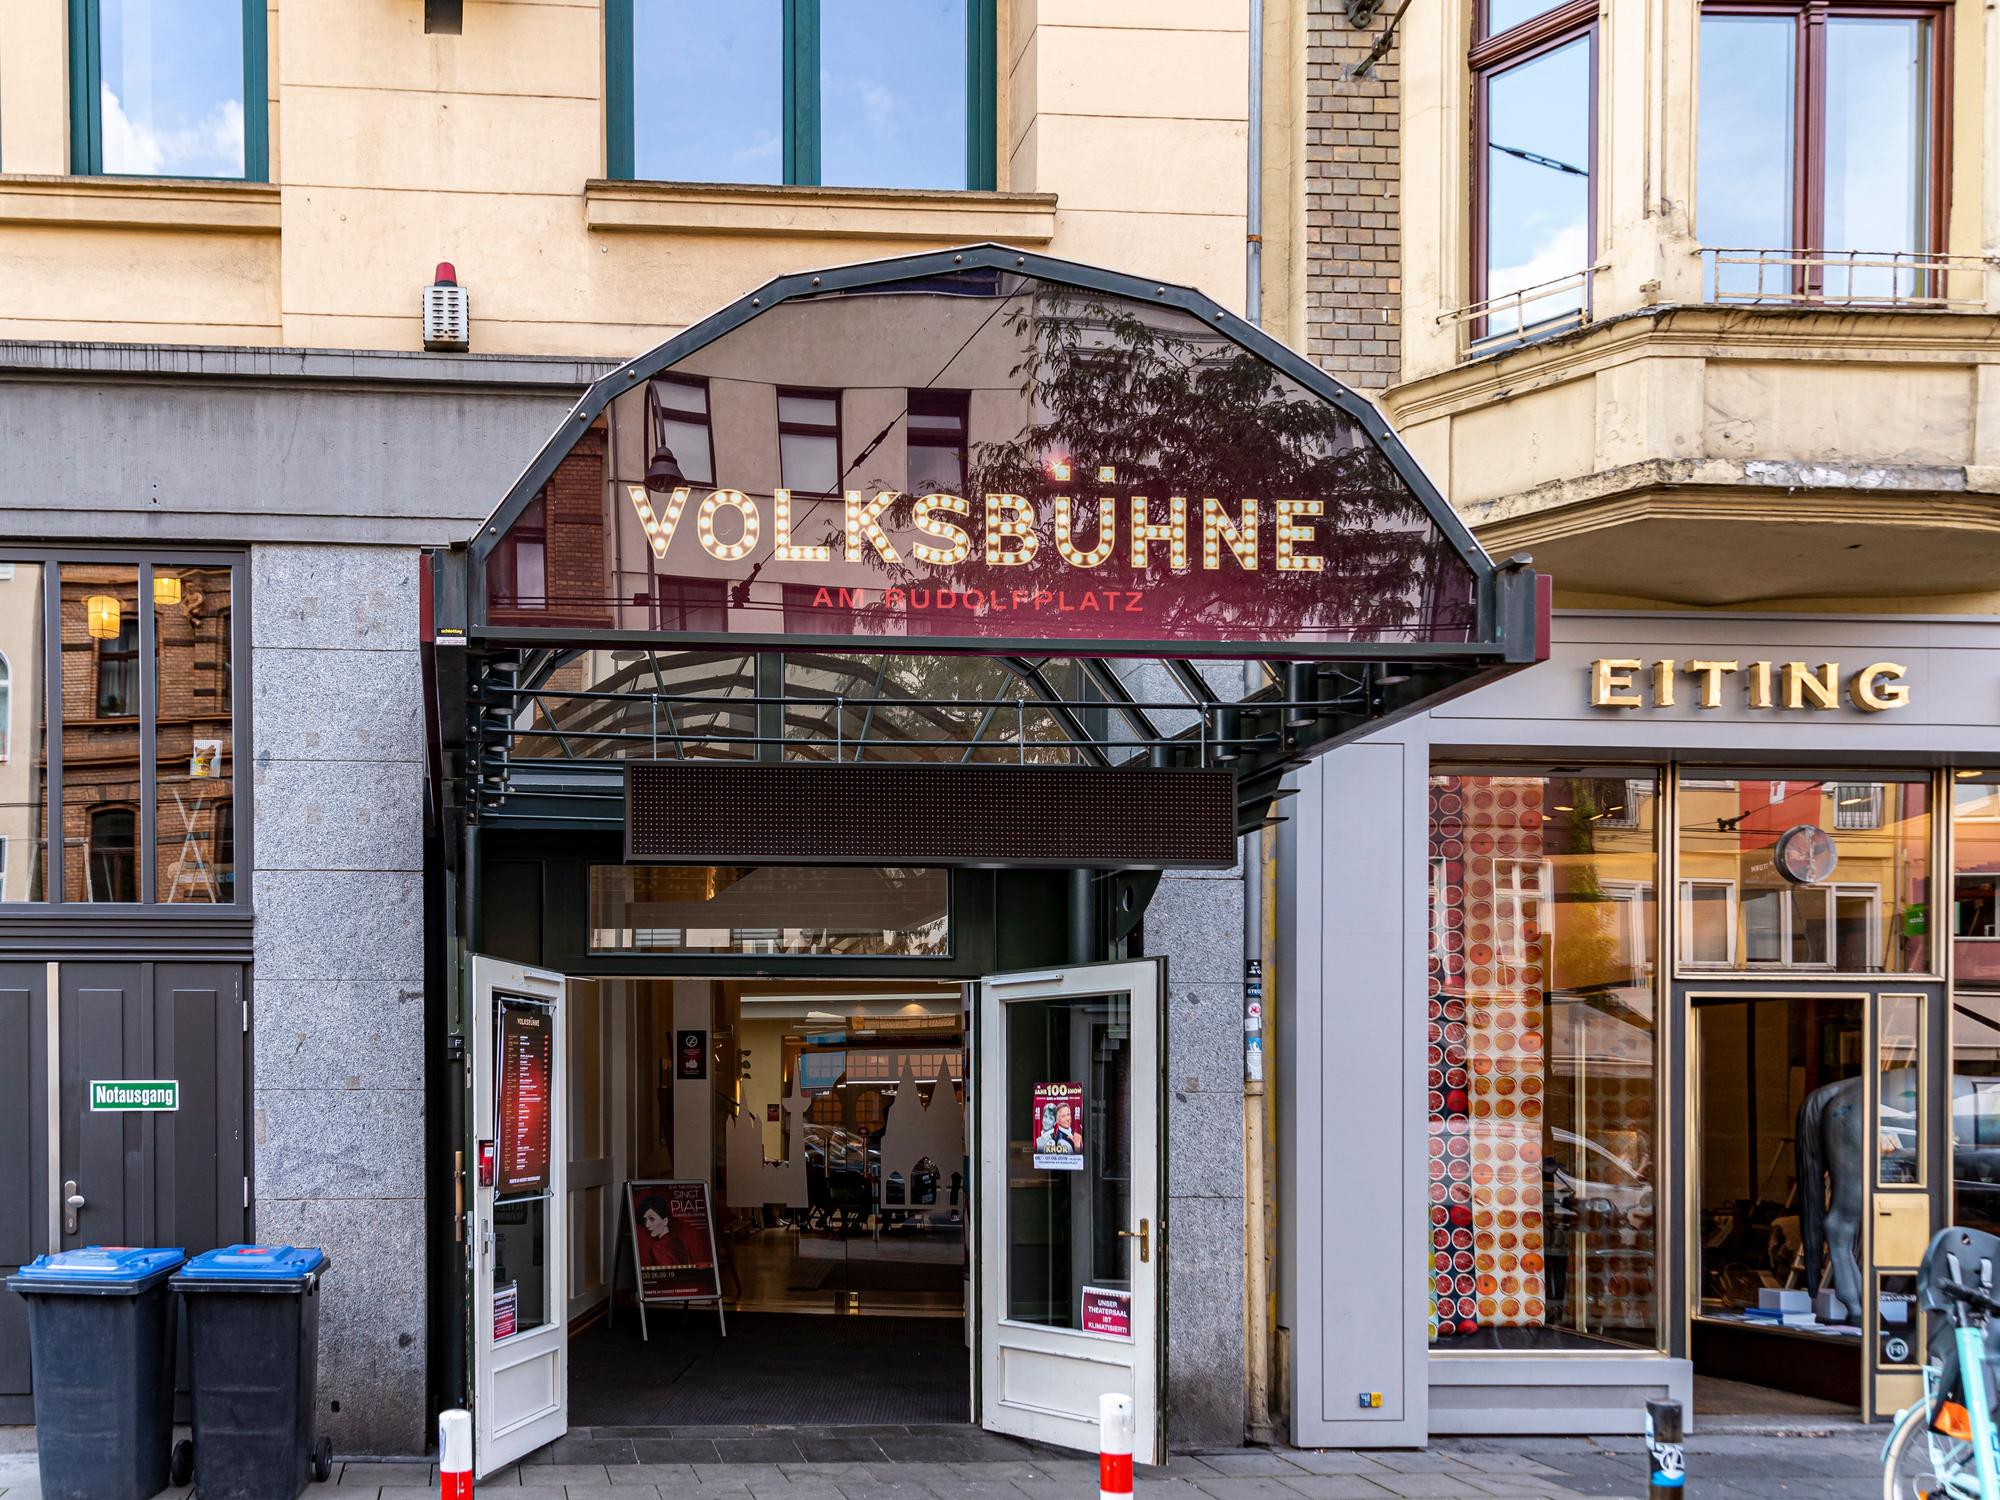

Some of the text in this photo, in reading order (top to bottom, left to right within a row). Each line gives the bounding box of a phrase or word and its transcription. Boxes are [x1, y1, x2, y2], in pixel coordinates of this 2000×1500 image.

[627, 465, 1324, 571] VOLKSBÜHNE
[812, 586, 1143, 612] AM RUDOLFPLATZ
[1590, 658, 1911, 713] EITING
[96, 1085, 173, 1106] Notausgang
[1047, 1084, 1067, 1096] 100
[673, 1189, 700, 1199] SINGT
[670, 1199, 705, 1213] PIAF
[1097, 1299, 1118, 1308] UNSER
[1087, 1305, 1128, 1318] THEATERSAAL
